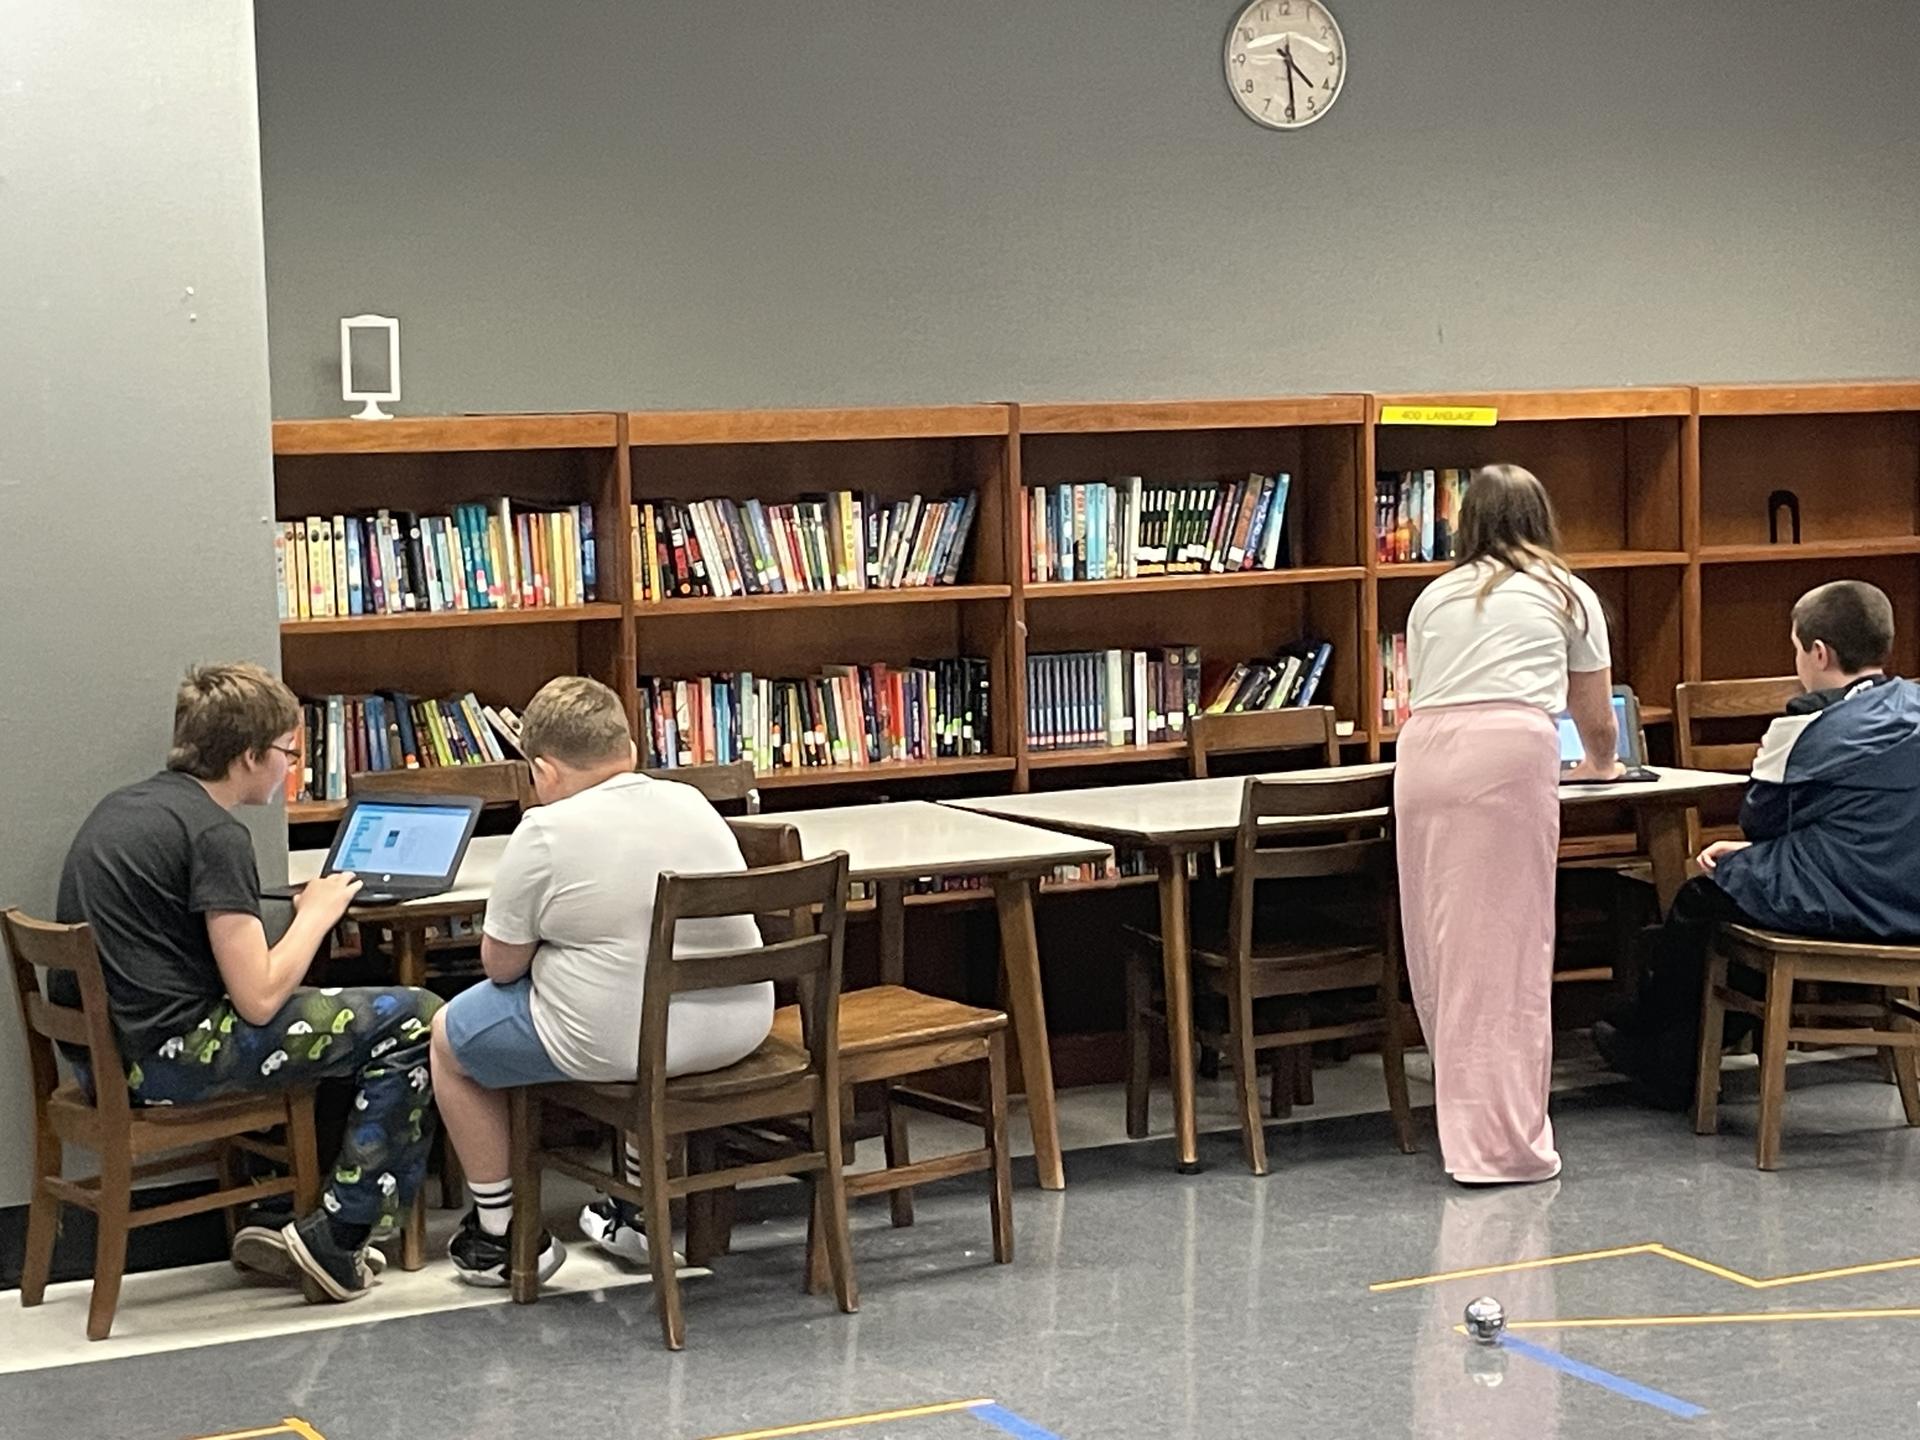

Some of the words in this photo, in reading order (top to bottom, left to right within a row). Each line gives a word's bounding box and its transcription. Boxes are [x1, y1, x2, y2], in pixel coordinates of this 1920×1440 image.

[1260, 9, 1269, 21] 11
[1279, 1, 1291, 16] 12
[1321, 26, 1328, 39] 2
[1237, 53, 1246, 68] 9
[1327, 51, 1335, 66] 3
[1245, 79, 1254, 94] 8
[1322, 78, 1330, 91] 4
[1263, 98, 1272, 112] 7
[1284, 103, 1293, 118] 6
[1307, 96, 1315, 111] 5
